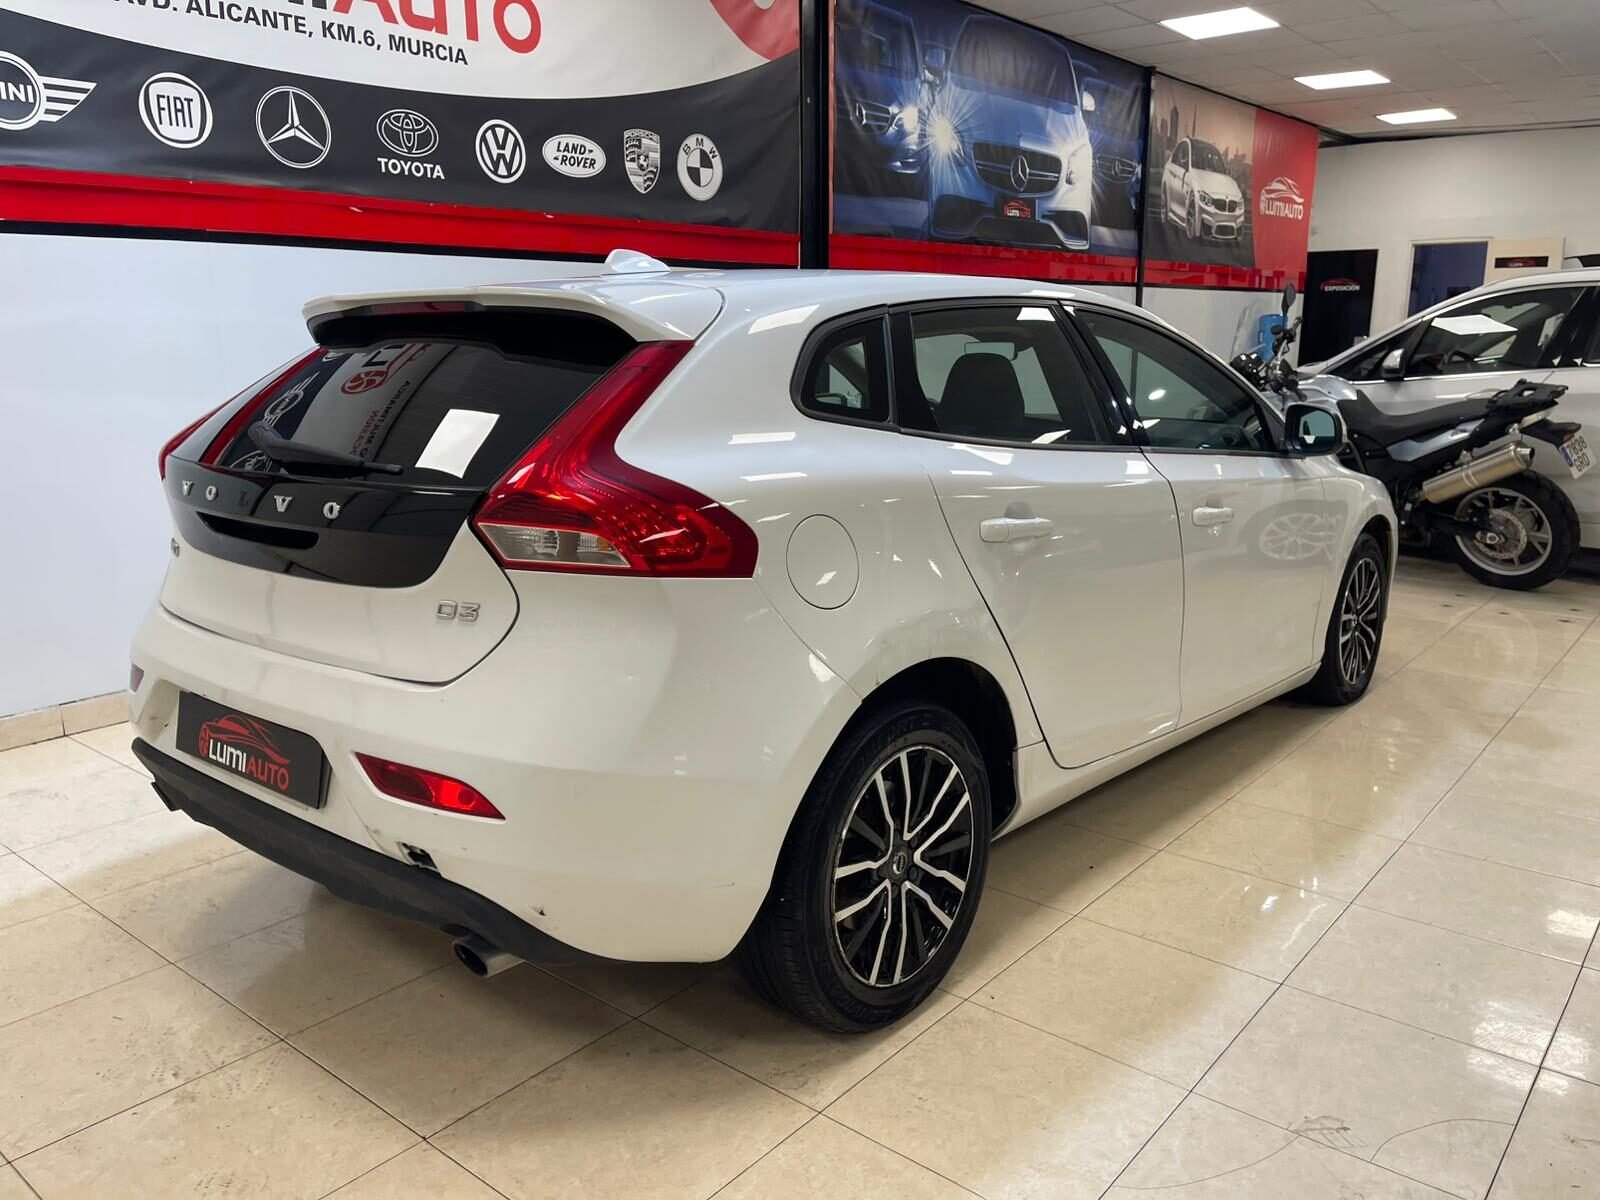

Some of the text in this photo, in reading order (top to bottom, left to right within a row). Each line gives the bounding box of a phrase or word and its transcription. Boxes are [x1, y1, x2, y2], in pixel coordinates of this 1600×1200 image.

[185, 0, 313, 38] ALICANTE,
[321, 20, 381, 51] KM.6,
[388, 34, 468, 65] MURCIA
[156, 94, 193, 128] FIAT
[556, 141, 587, 156] LAND
[682, 137, 718, 160] BMW
[377, 157, 445, 180] TOYOTA
[560, 157, 597, 170] ROVER
[436, 599, 481, 623] D3
